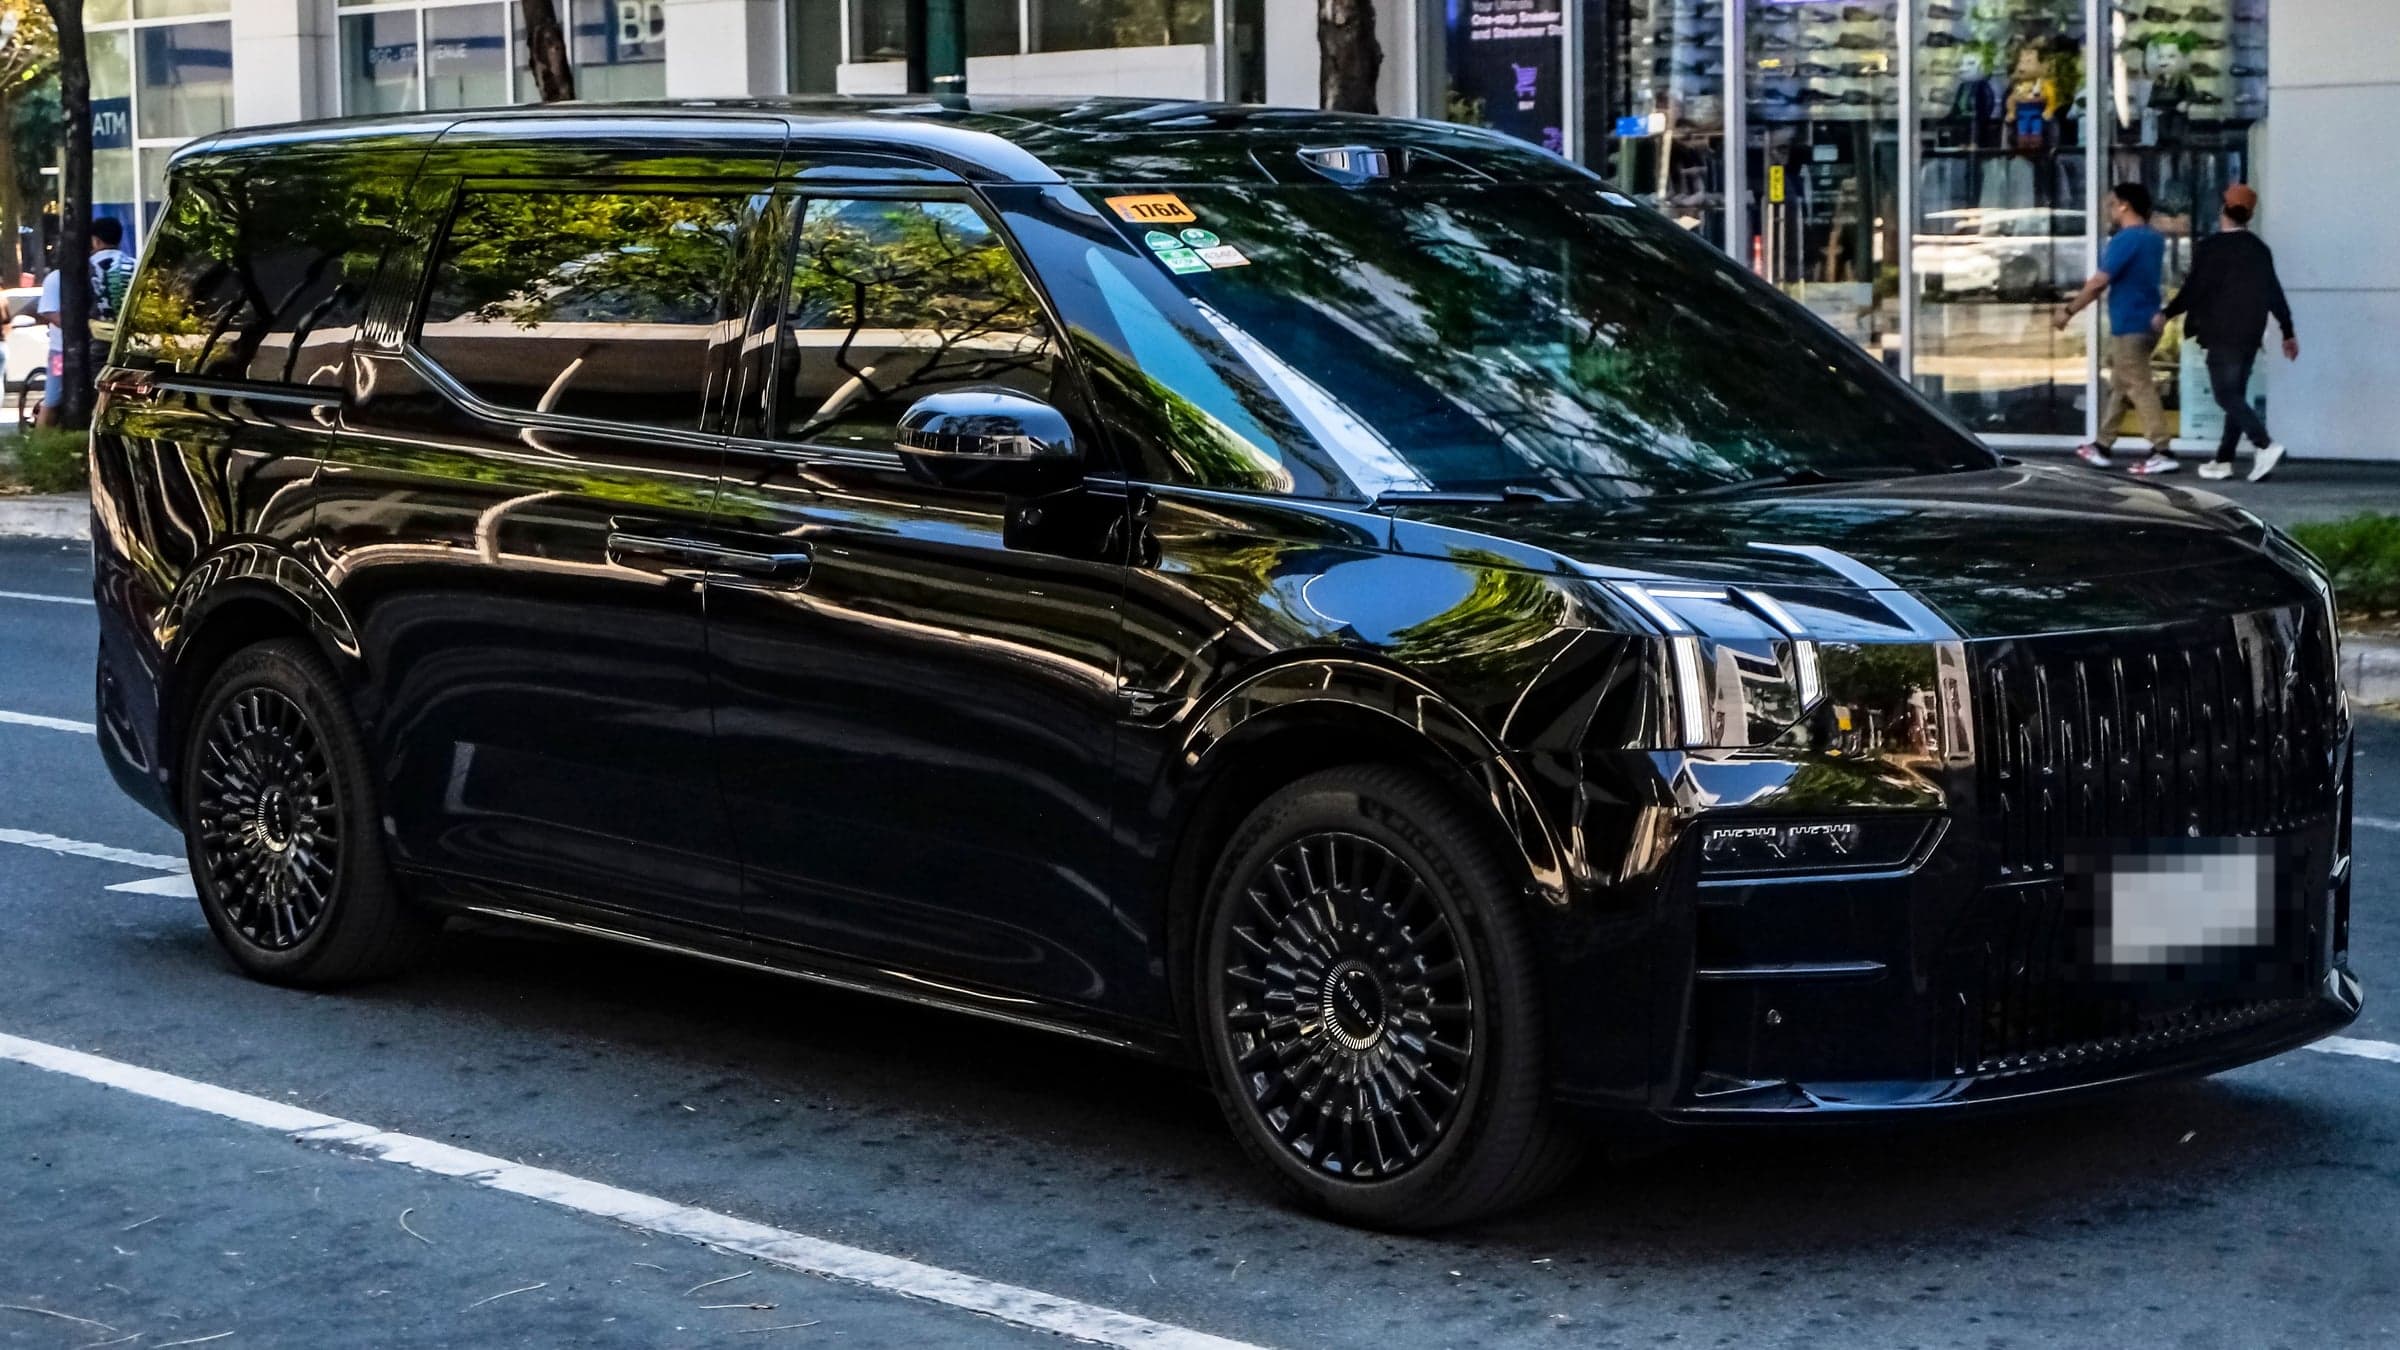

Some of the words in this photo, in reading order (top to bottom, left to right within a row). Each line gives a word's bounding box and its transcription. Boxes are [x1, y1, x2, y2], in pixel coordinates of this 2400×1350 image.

[1471, 14, 1518, 26] One-stop
[1519, 11, 1561, 23] Sneaker
[1471, 29, 1491, 40] and
[1493, 26, 1546, 38] Streetwear
[92, 112, 126, 136] ATM
[1130, 202, 1187, 218] 176A
